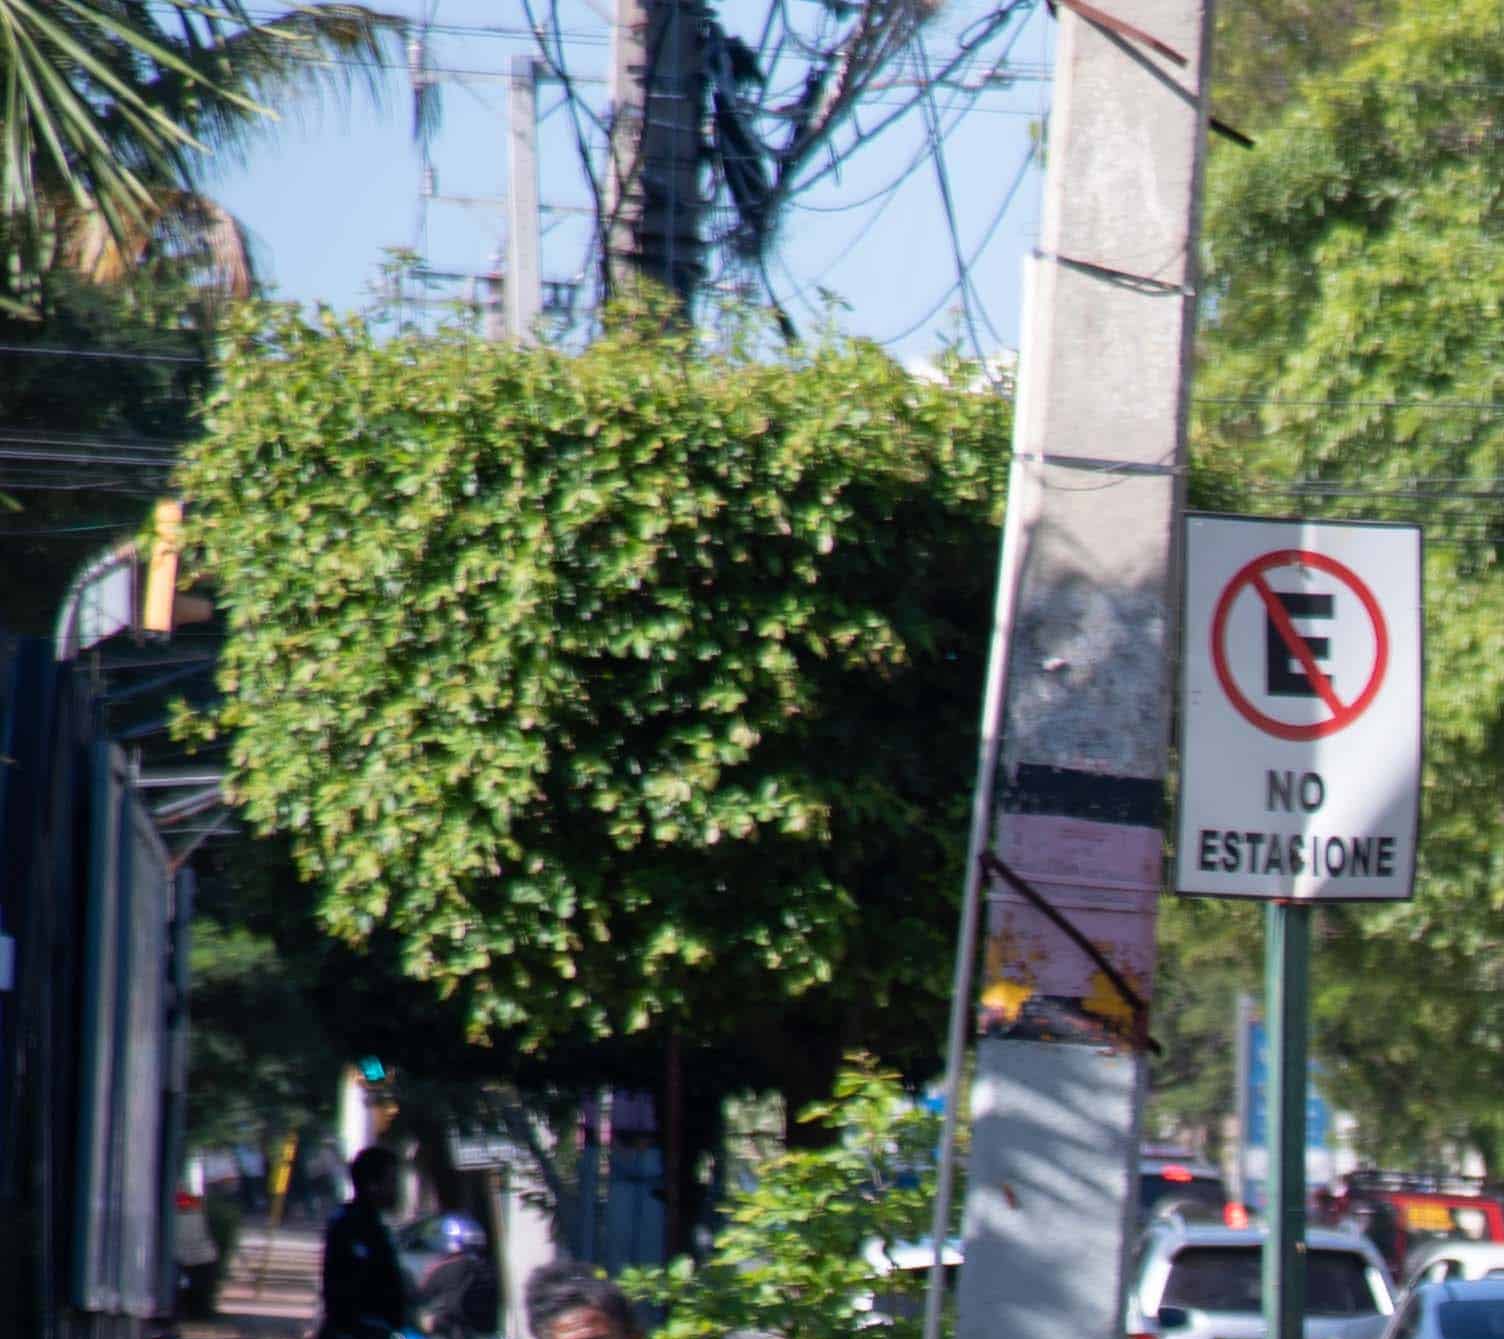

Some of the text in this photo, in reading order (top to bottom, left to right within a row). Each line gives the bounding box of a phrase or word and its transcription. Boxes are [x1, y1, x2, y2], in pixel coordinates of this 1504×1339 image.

[1266, 592, 1335, 697] E
[1265, 769, 1326, 813] NO
[1199, 829, 1398, 878] ESTACIONE
